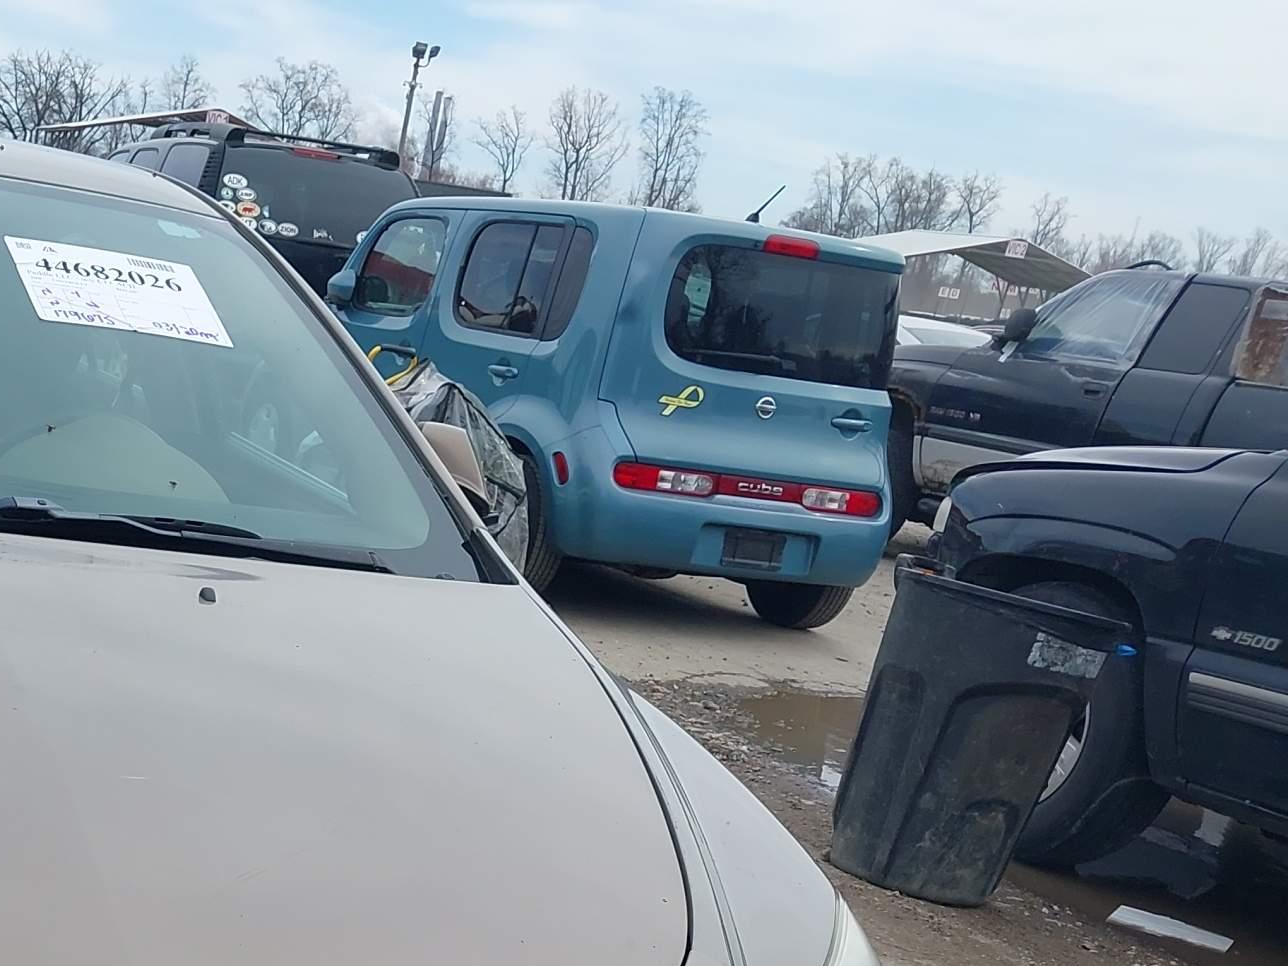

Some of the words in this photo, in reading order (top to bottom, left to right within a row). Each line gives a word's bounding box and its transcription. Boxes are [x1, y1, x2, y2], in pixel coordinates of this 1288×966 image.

[227, 176, 244, 186] ADK
[279, 223, 297, 235] ZION
[35, 257, 183, 293] 44682026
[737, 481, 784, 496] cube
[1233, 631, 1282, 651] 1500
